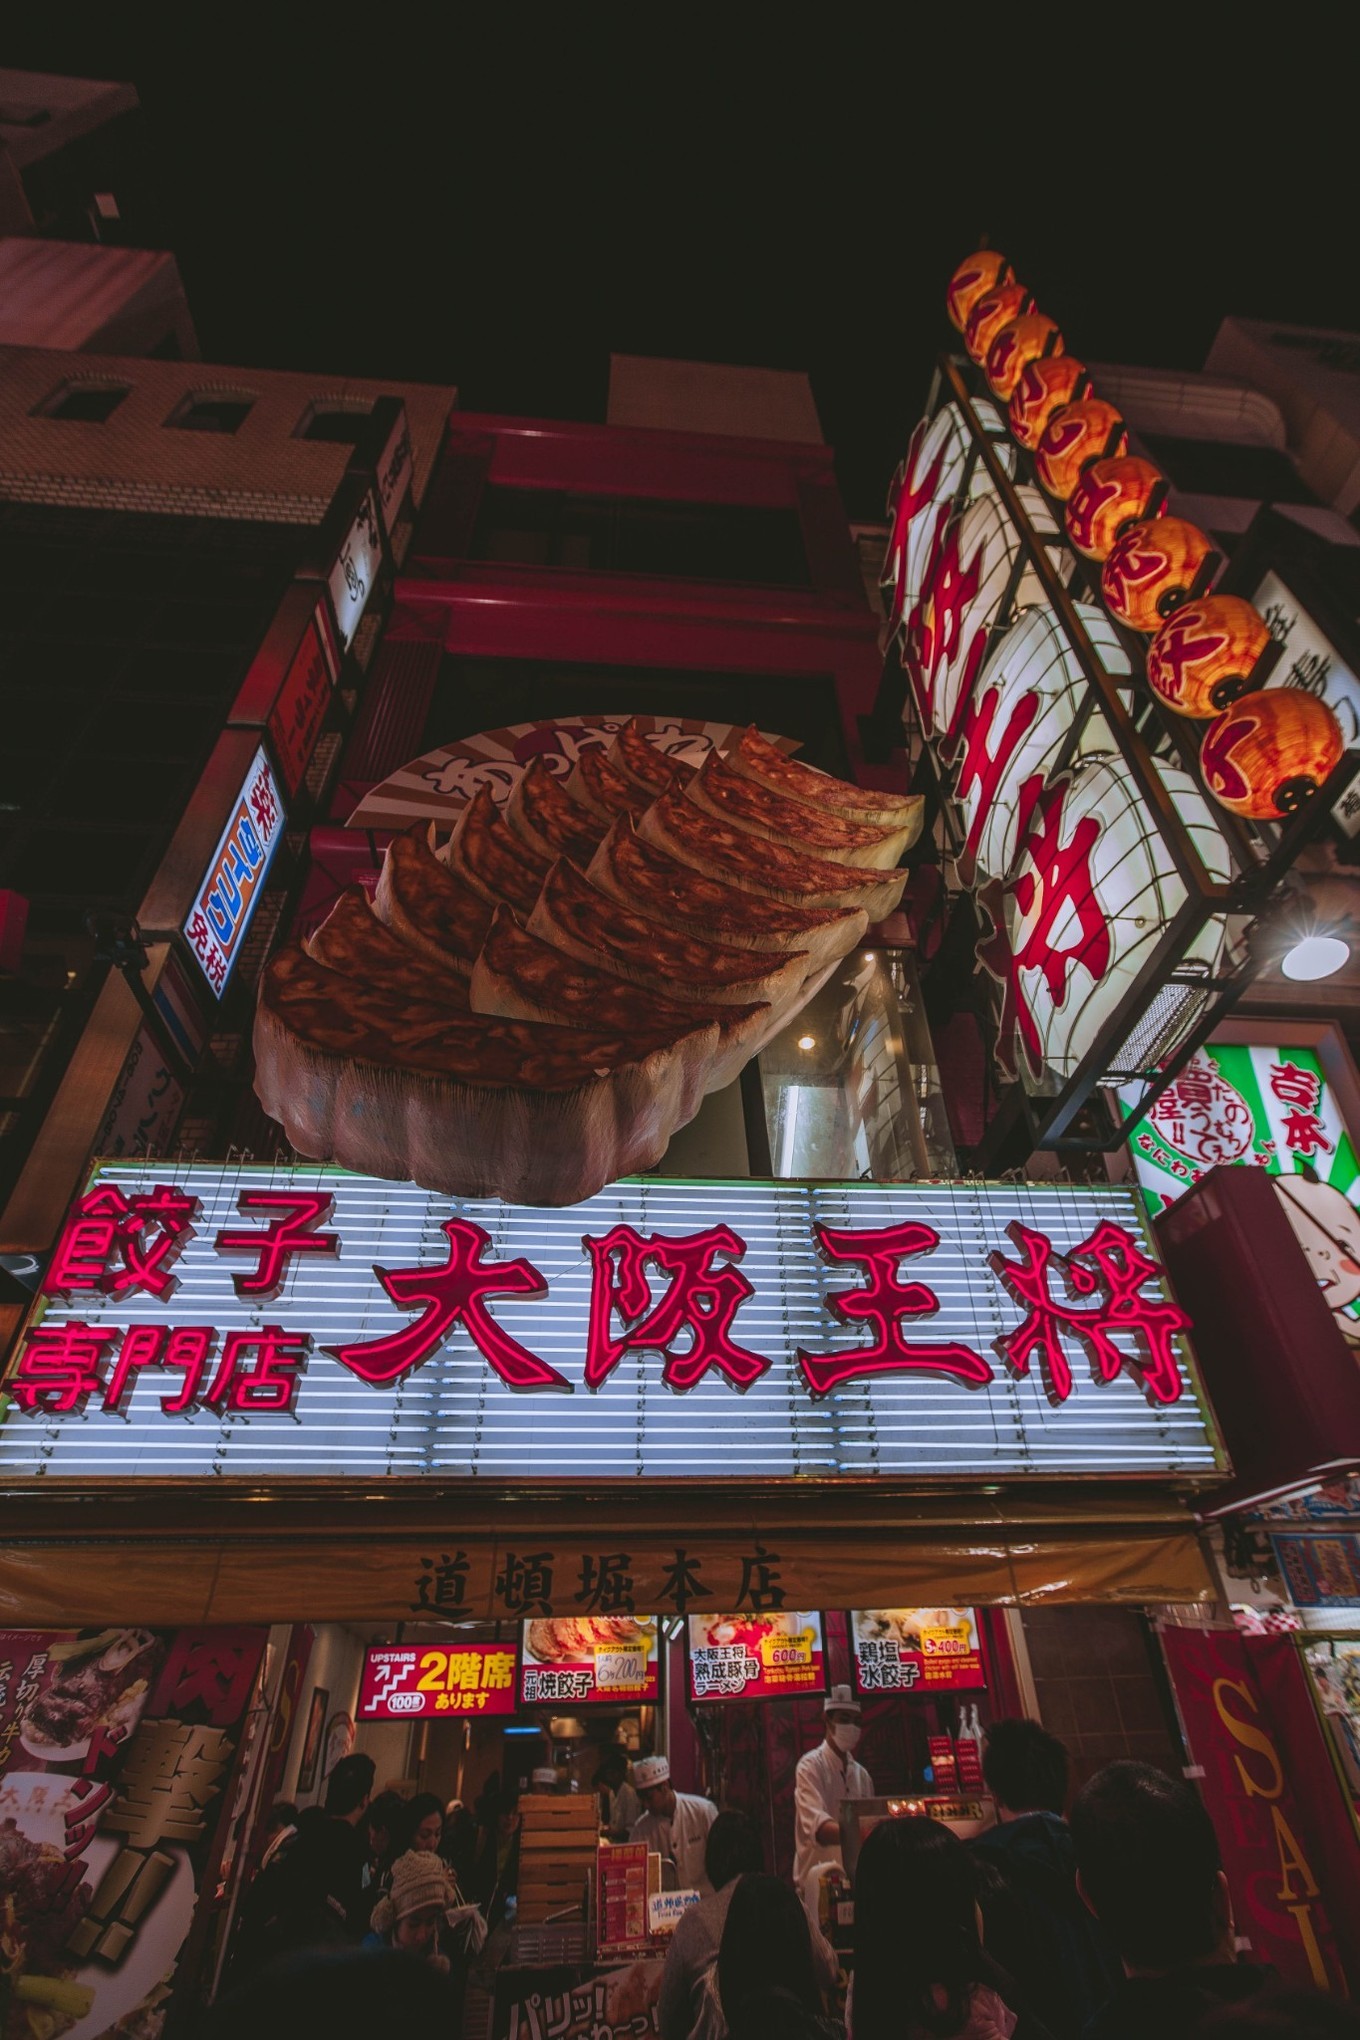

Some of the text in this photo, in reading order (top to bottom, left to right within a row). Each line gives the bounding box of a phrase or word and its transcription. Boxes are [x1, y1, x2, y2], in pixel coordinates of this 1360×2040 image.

[205, 815, 263, 946] ダイコク
[187, 911, 227, 992] 免税
[1269, 1062, 1330, 1153] 吉本
[41, 1184, 341, 1302] 餃子
[320, 1217, 1193, 1406] 大阪王将
[3, 1321, 314, 1419] 専門店
[409, 1546, 786, 1618] 道頓堀本店
[370, 1652, 416, 1663] UPSTAIRS
[416, 1651, 515, 1691] 2階席
[694, 1646, 744, 1661] 大阪王将
[695, 1660, 758, 1680] 熟成豚骨
[538, 1672, 594, 1699] 焼餃子
[695, 1680, 745, 1694] ラーメン
[860, 1663, 919, 1687] 水餃子
[435, 1692, 490, 1709] あります
